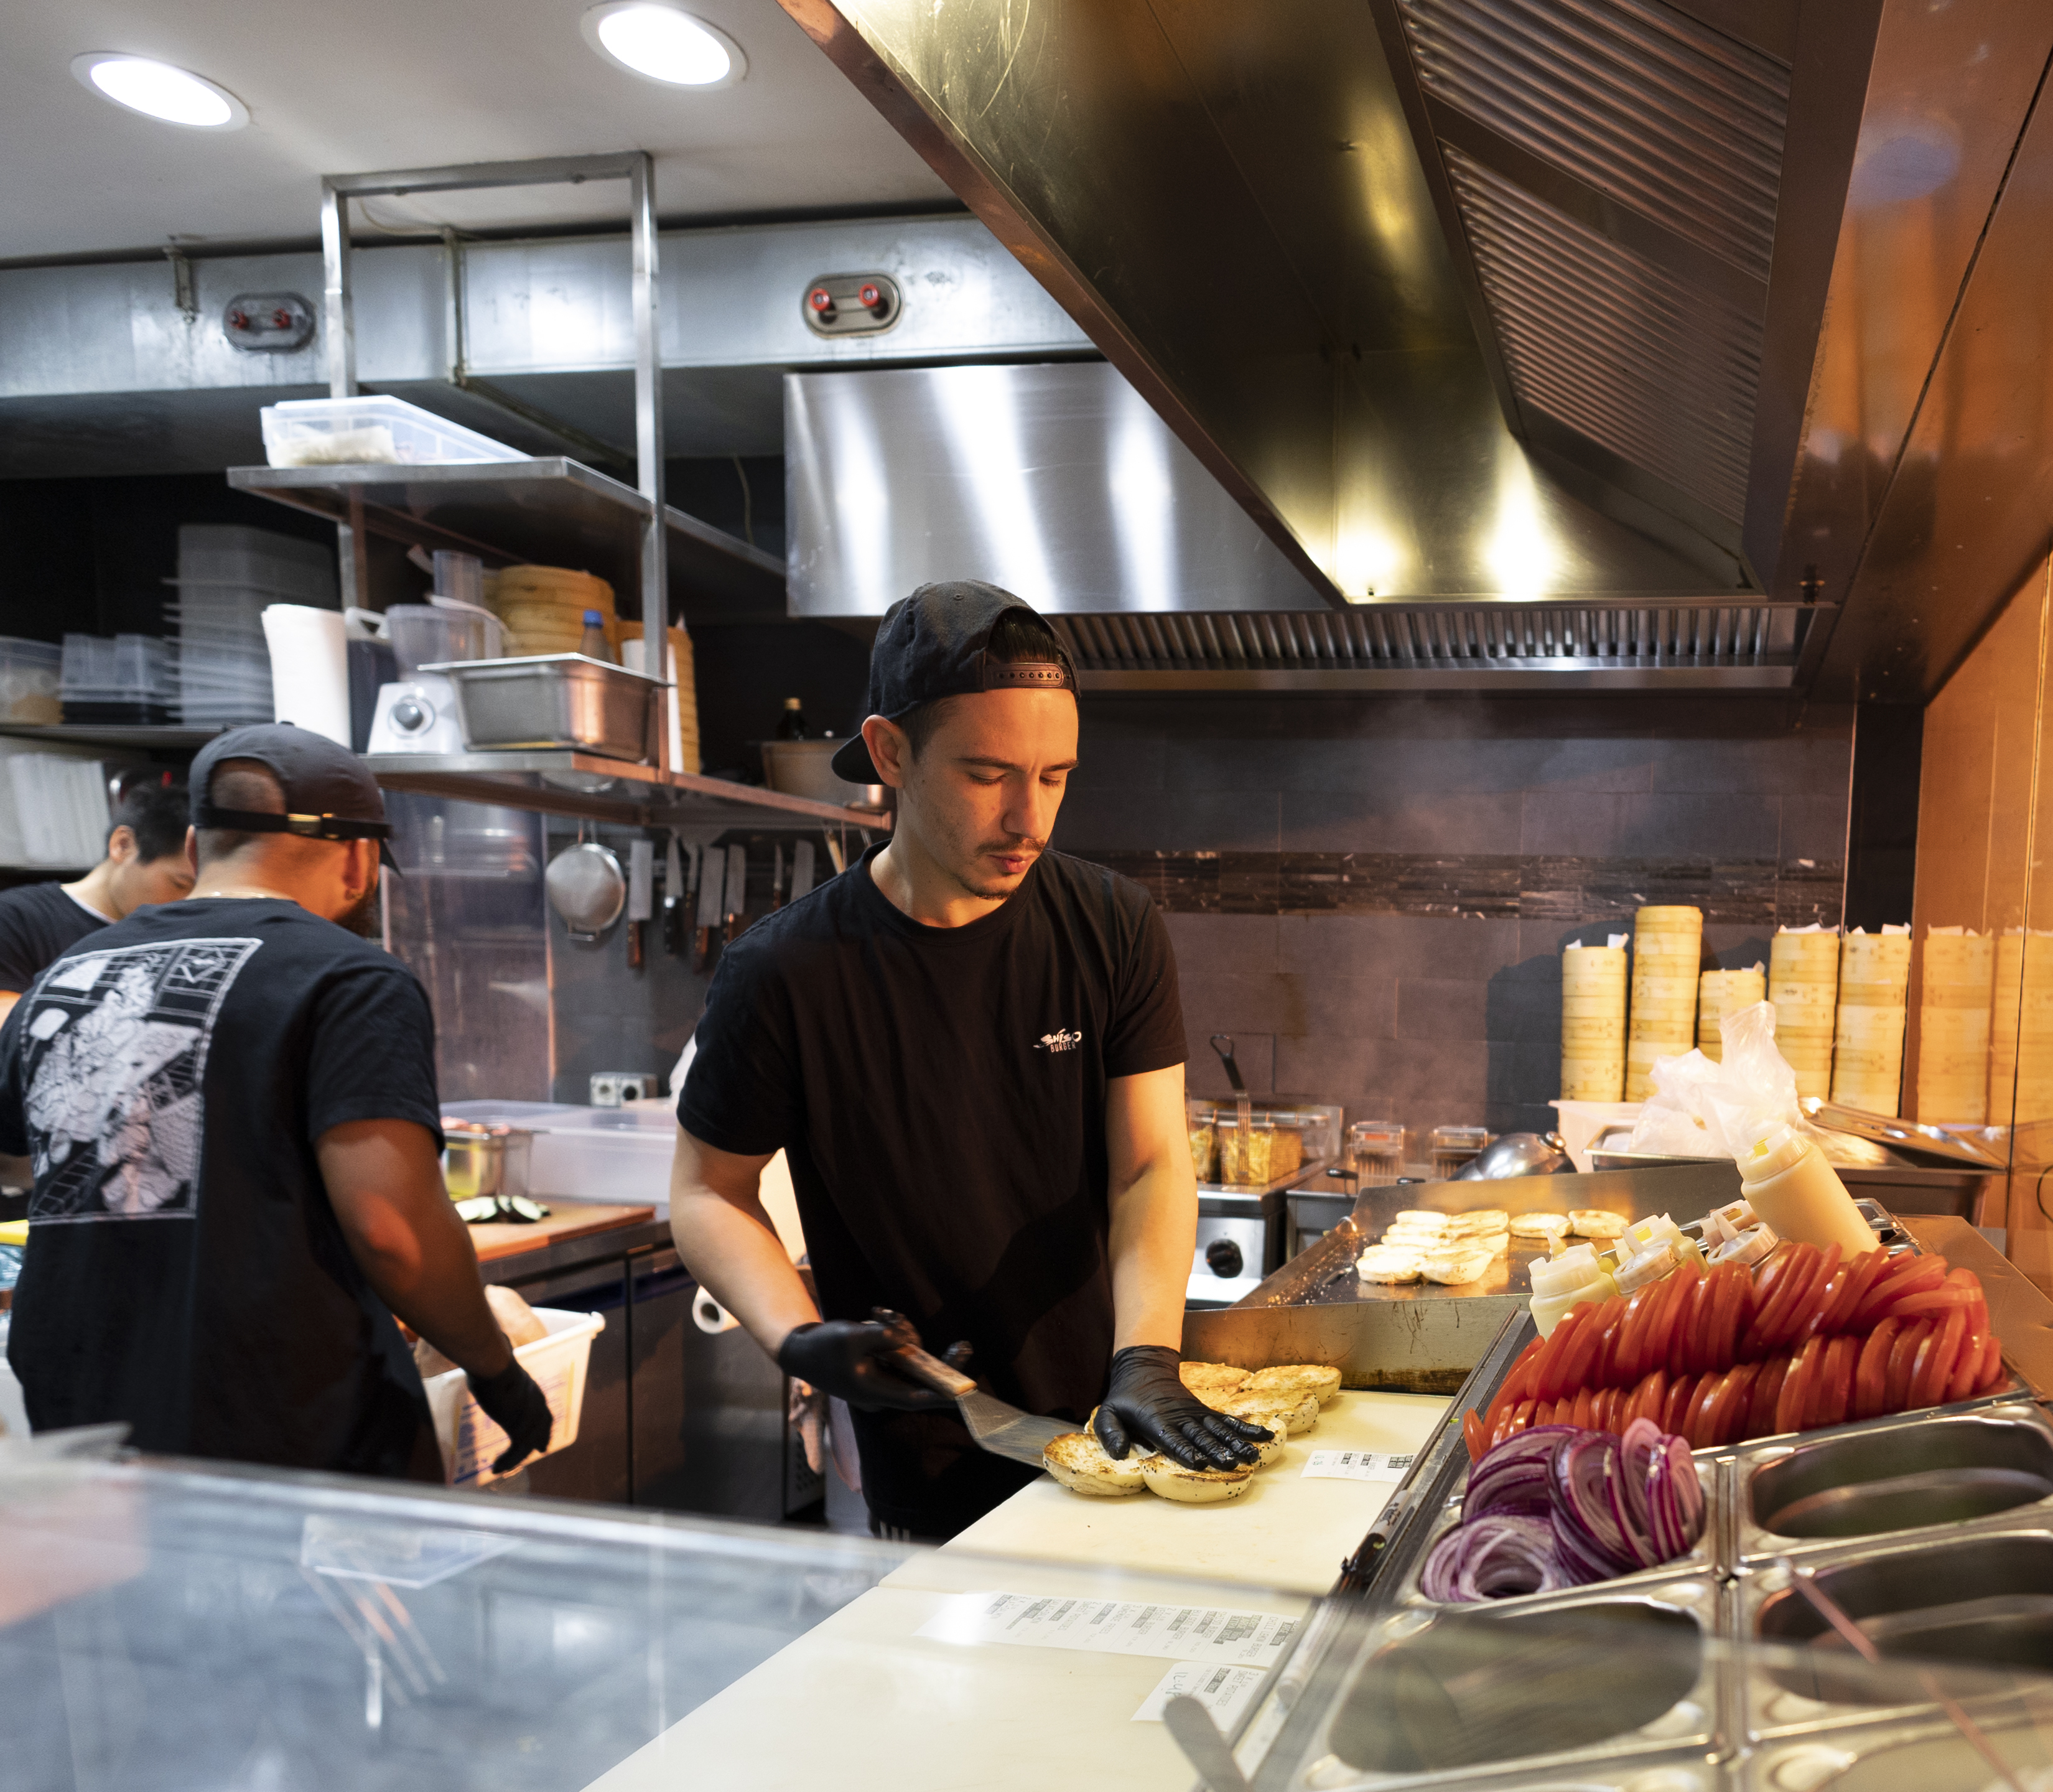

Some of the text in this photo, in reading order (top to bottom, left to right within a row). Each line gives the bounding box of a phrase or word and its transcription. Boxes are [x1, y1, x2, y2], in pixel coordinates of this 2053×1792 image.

[1050, 1042, 1076, 1053] BURGER
[1211, 1610, 1228, 1625] SHISO
[1263, 1616, 1280, 1630] CHILI
[1097, 1622, 1117, 1635] FRIES
[1135, 1621, 1155, 1635] BURGER
[1170, 1626, 1189, 1640] BURGER
[1200, 1625, 1219, 1638] BURGER
[1244, 1643, 1263, 1658] BURGER
